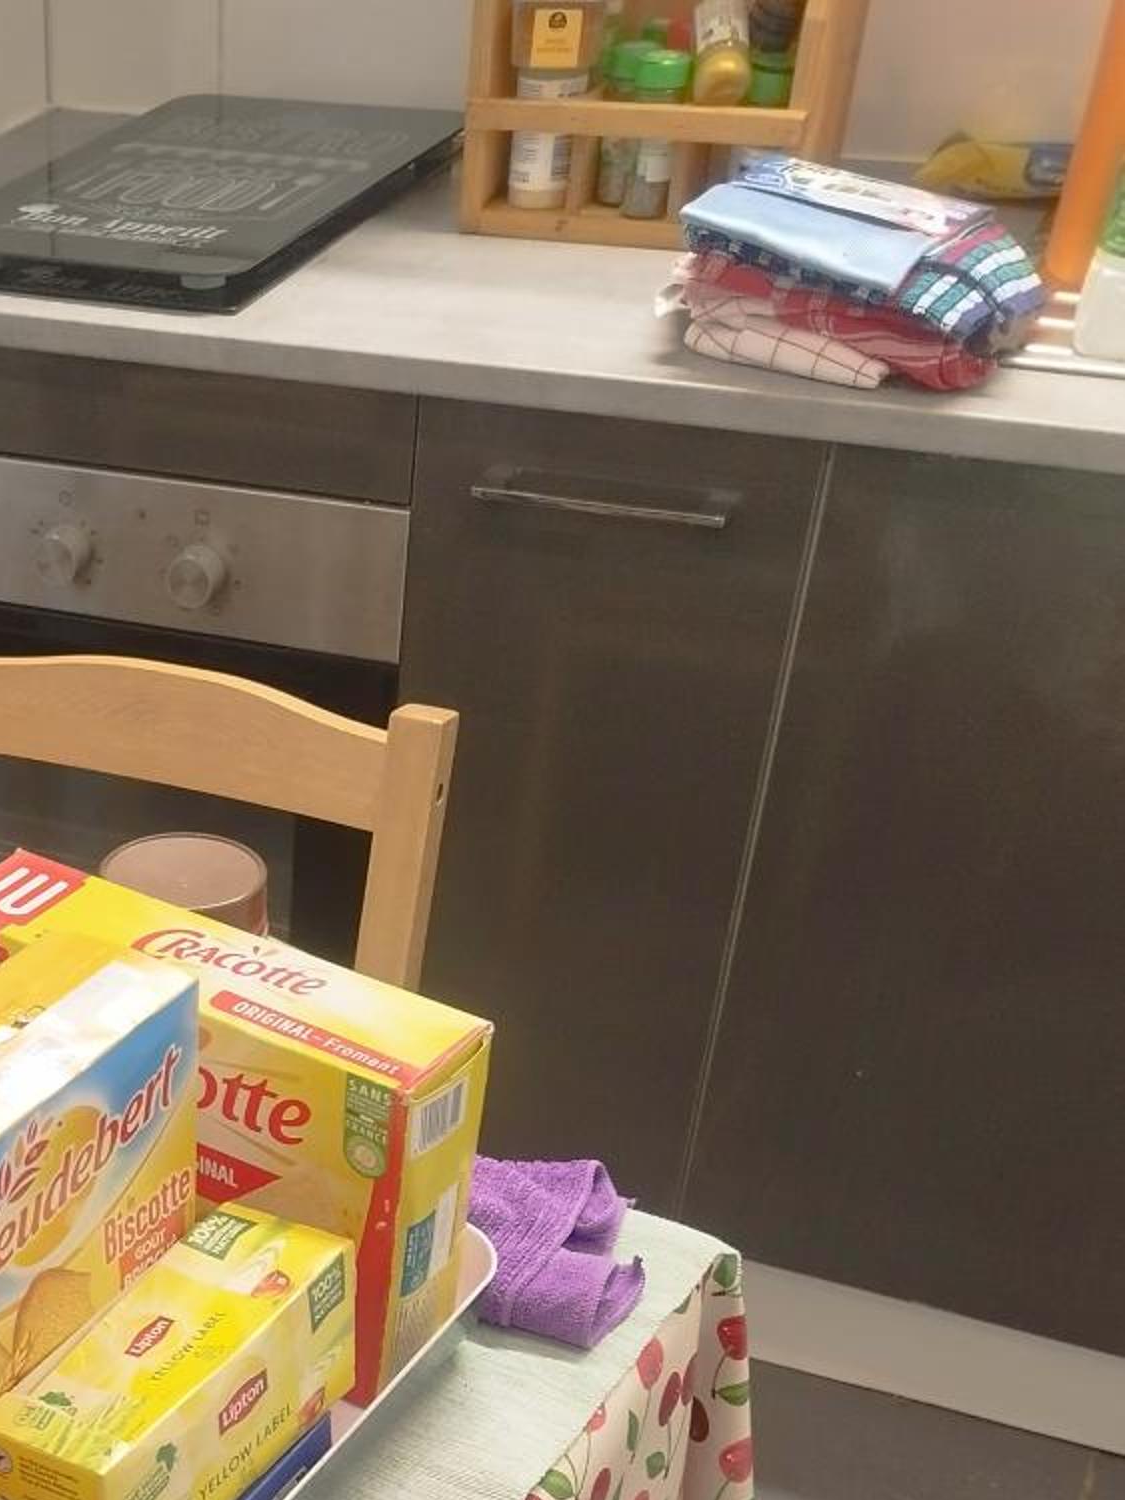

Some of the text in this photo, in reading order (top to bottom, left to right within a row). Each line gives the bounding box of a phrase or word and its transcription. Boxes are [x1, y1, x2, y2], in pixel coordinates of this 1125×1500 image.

[233, 1001, 314, 1040] ORIGINAL
[322, 1037, 402, 1075] Froment
[196, 1066, 313, 1145] otte
[198, 1155, 239, 1189] INAL
[103, 1166, 191, 1266] Biscotte
[129, 1318, 169, 1356] Lipton
[150, 1344, 193, 1382] YELLOW
[221, 1377, 265, 1427] Lipton
[255, 1403, 292, 1447] LABEL
